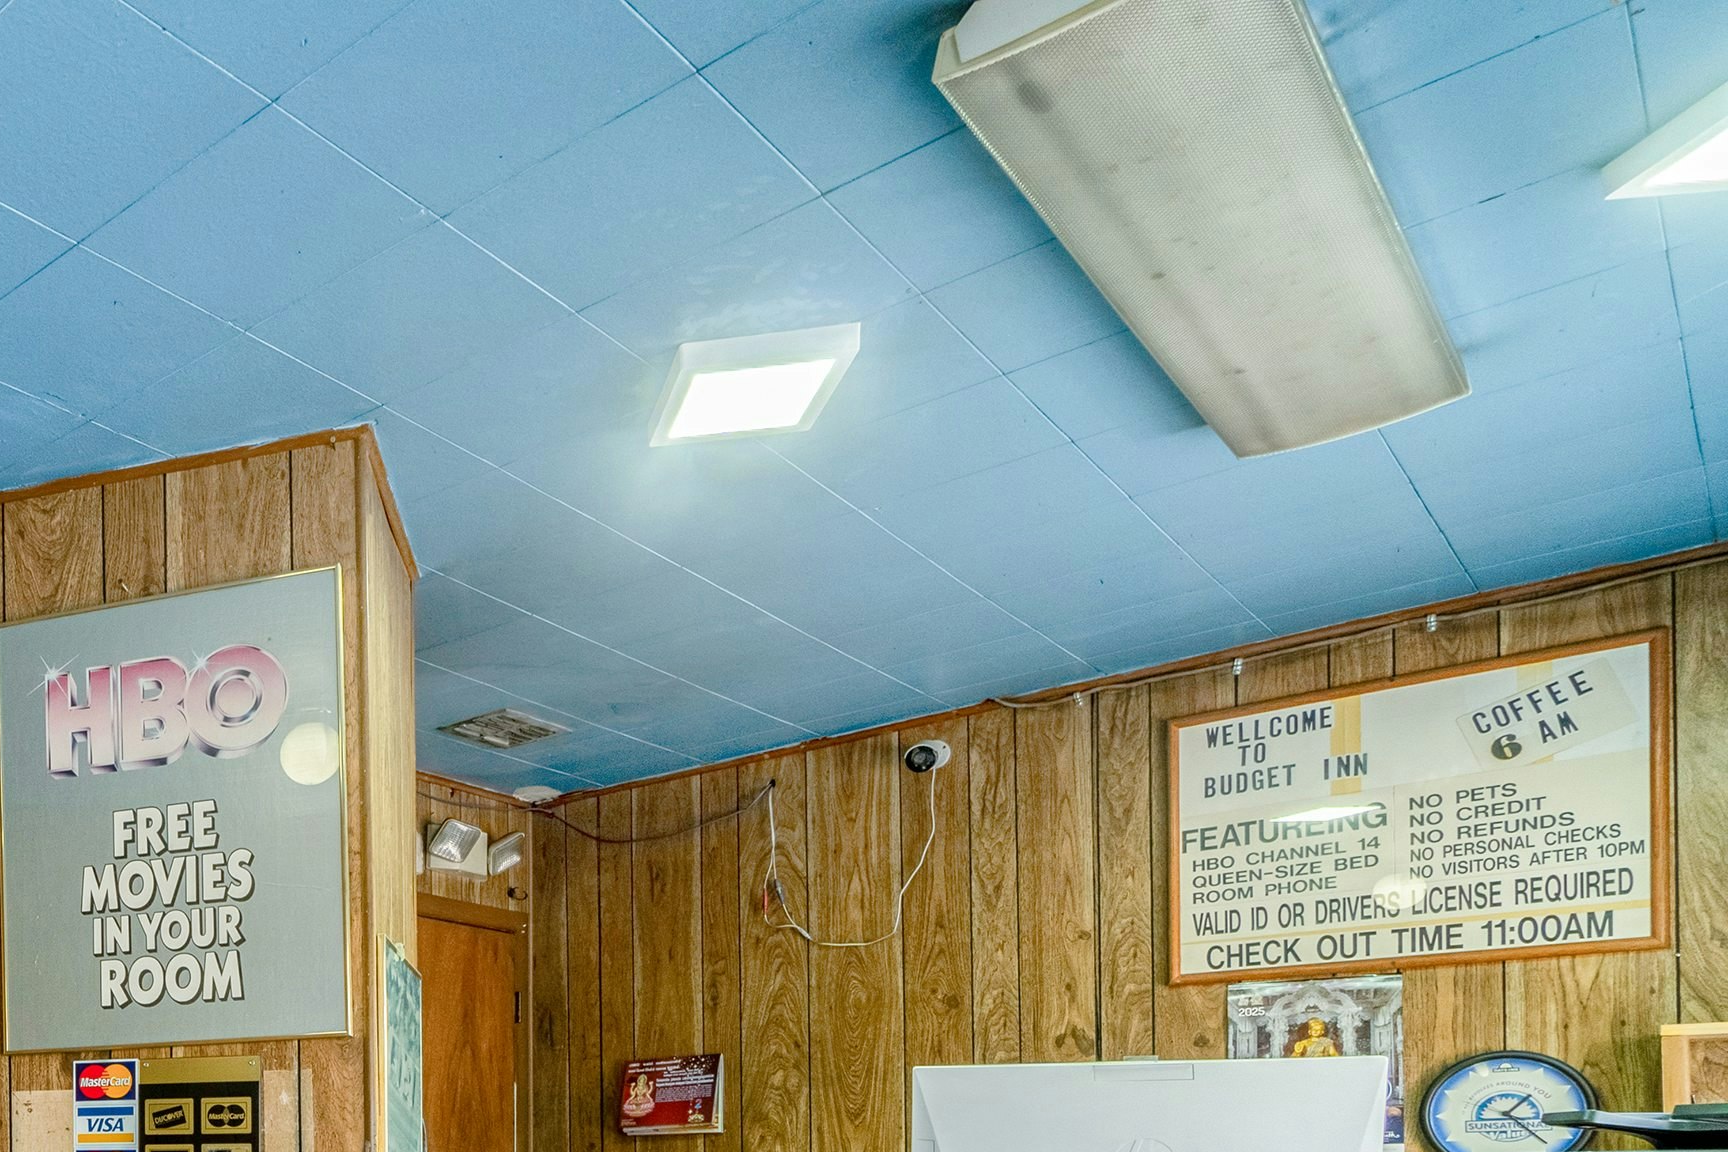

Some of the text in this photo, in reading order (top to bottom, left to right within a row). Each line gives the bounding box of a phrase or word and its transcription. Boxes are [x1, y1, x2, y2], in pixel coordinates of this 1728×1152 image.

[45, 643, 288, 780] HBO
[1472, 671, 1594, 734] COFFEE
[1206, 706, 1333, 749] WELLCOME
[1491, 713, 1579, 760] 6 AM
[1238, 743, 1266, 767] TO
[1204, 753, 1368, 798] BUDGET INN
[1409, 783, 1517, 811] NO PETS
[1409, 796, 1547, 828] NO CREDIT
[113, 799, 220, 859] FREE
[1409, 812, 1574, 845] NO REFUNDS
[1410, 824, 1621, 862] NO PERSONAL CHECKS
[1193, 837, 1380, 872] HBO CHANNEL 14
[1193, 855, 1379, 889] QUEEN-SIZE BED
[1410, 840, 1645, 880] NO VISITORS AFTER 10PM
[81, 848, 254, 915] MOVIES
[1193, 876, 1337, 904] ROOM PHONE
[1193, 868, 1633, 936] VALID ID OR DRIVERS LICENSE REQUIRED
[92, 906, 245, 956] IN YOUR
[1207, 910, 1614, 970] CHECK OUT TIME 11:00AM
[100, 950, 244, 1008] ROOM
[1238, 1007, 1265, 1017] 2025
[80, 1076, 131, 1089] MasterCard
[1534, 1087, 1551, 1099] YOU
[87, 1118, 124, 1133] VISA
